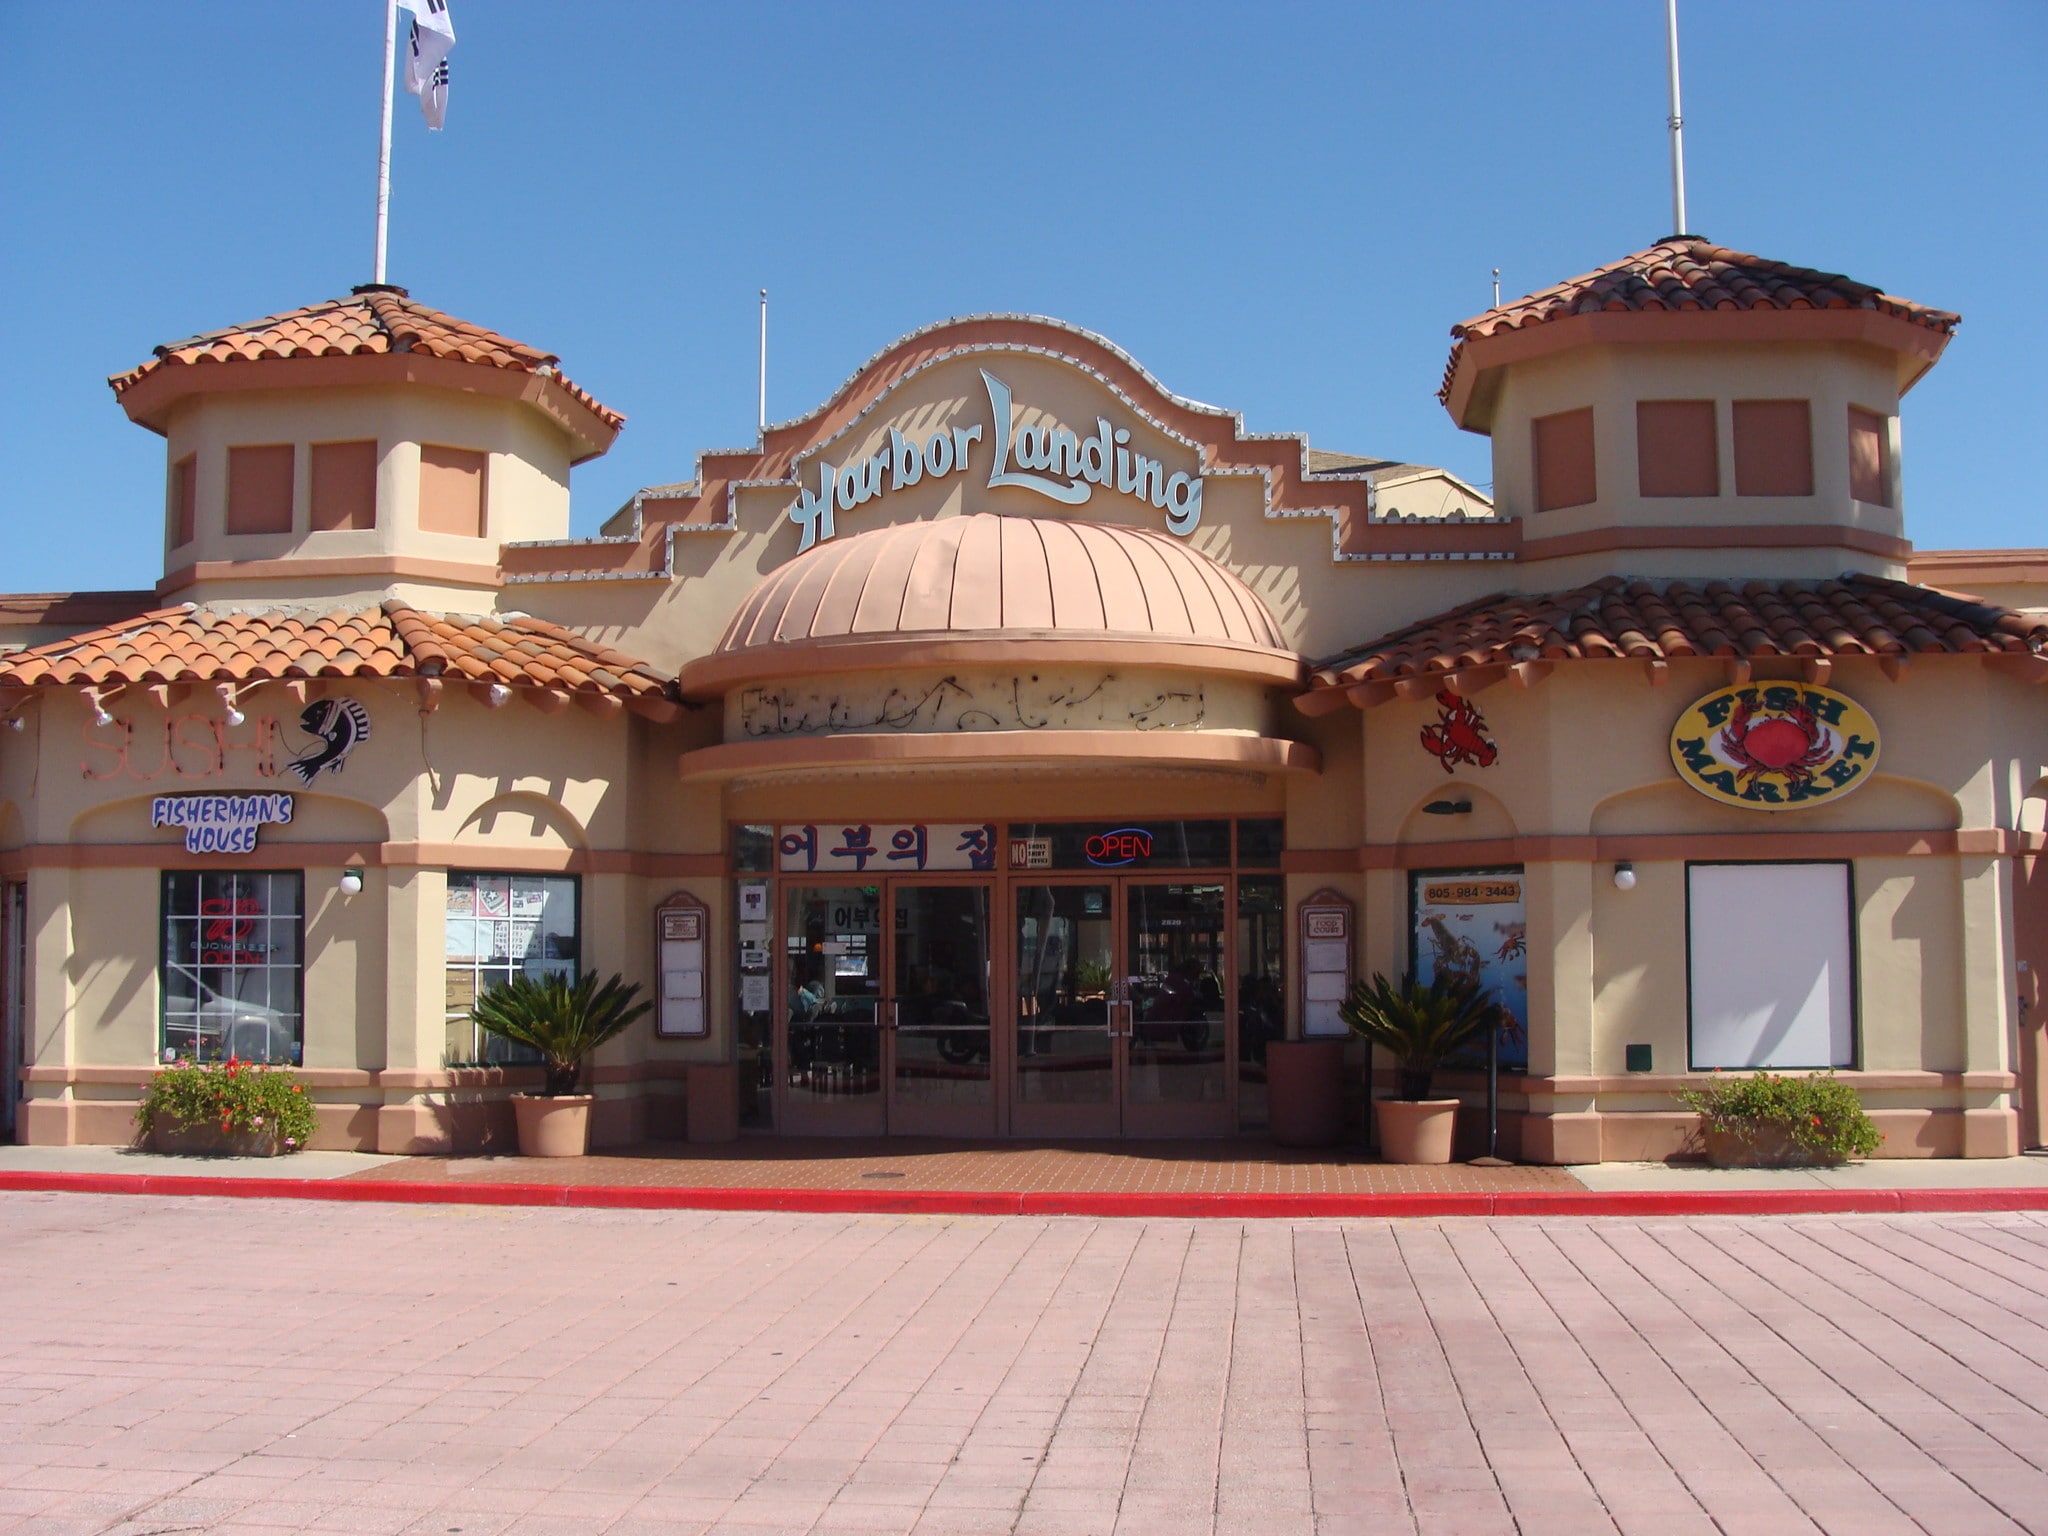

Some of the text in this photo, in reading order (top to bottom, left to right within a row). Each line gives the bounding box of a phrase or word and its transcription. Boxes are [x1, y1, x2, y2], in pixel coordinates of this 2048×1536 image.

[789, 368, 1203, 555] Harbor Landing
[1698, 687, 1848, 728] FISH
[80, 712, 275, 779] SUSHI
[1677, 734, 1875, 803] MARKET
[153, 795, 293, 825] FISHERMAN'S
[186, 826, 257, 851] HOUSE
[779, 824, 998, 871] 어부의 집
[1011, 843, 1026, 864] NO
[1085, 835, 1151, 858] OPEN
